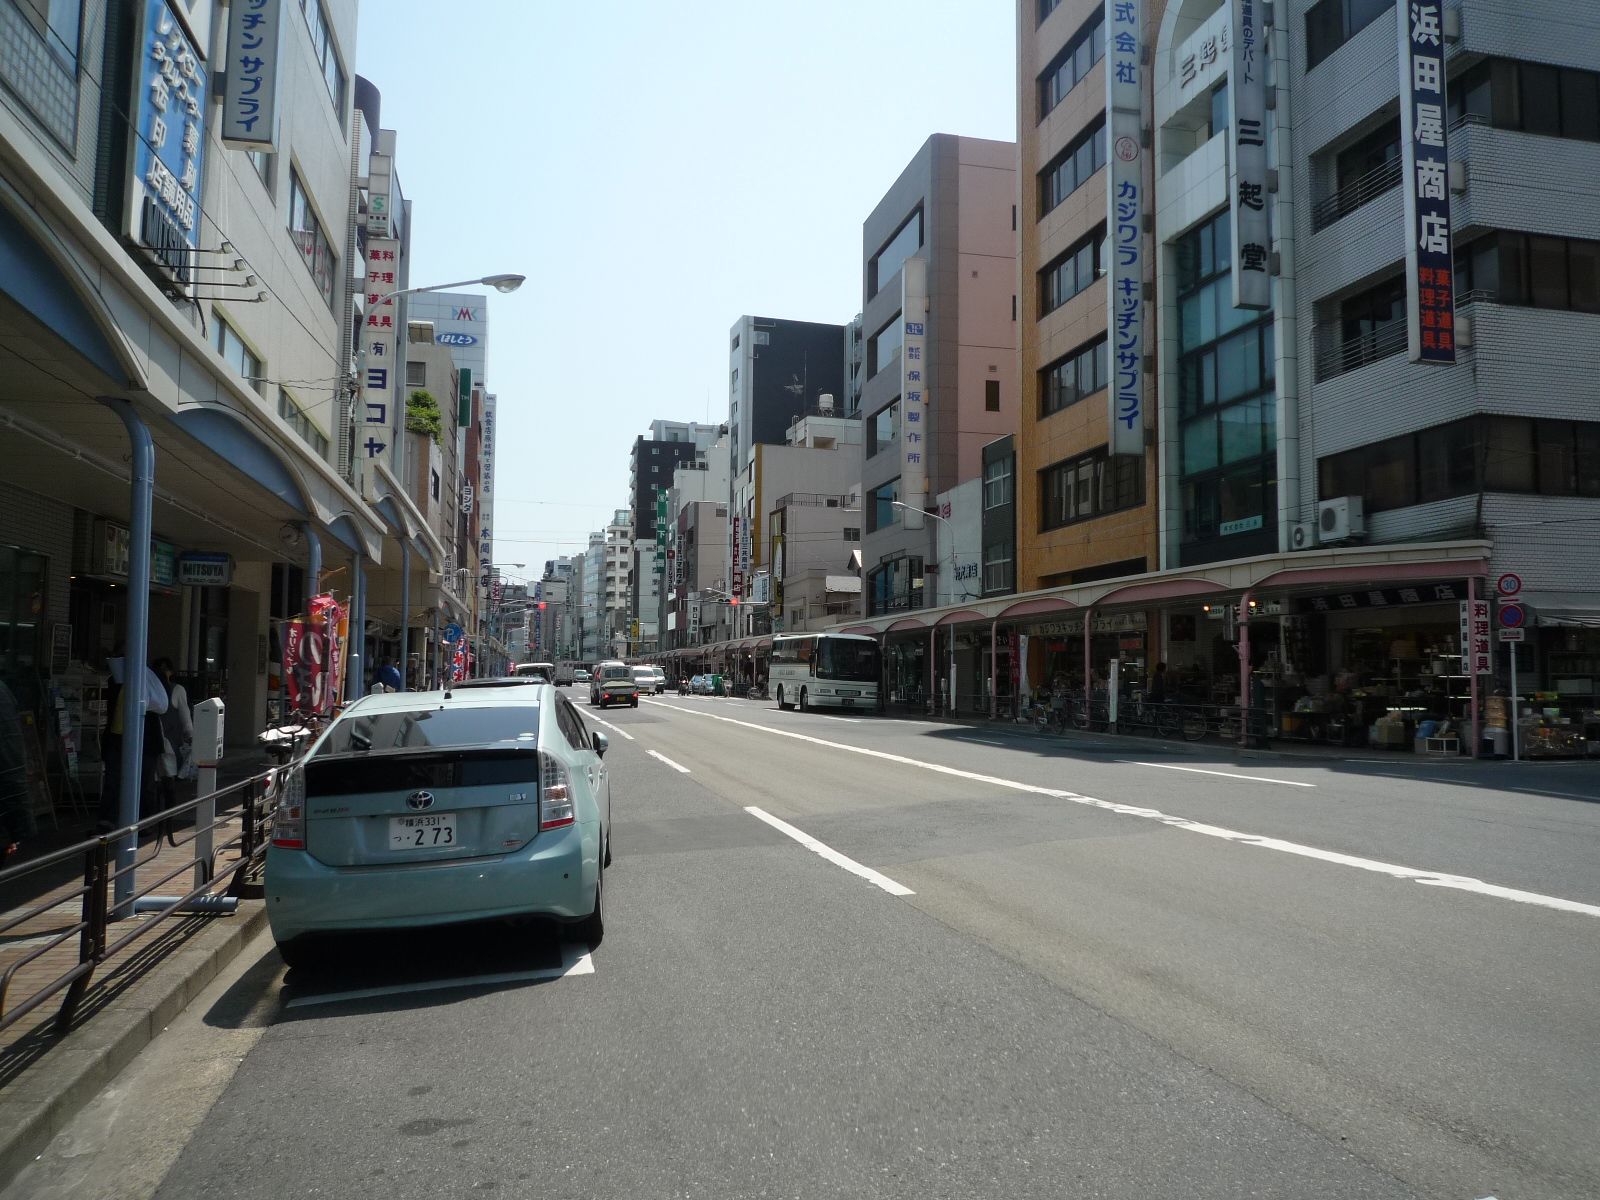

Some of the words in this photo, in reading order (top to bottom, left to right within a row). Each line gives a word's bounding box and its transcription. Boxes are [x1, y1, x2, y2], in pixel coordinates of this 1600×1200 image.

[1114, 2, 1136, 84] 式会社
[1410, 2, 1449, 255] 浜田屋商店
[1117, 180, 1138, 266] カジワラ
[1237, 117, 1267, 273] 三起堂
[440, 334, 473, 345] はしとう
[1116, 277, 1140, 430] キッチンサプライ
[364, 368, 388, 458] ヨコヤ
[907, 370, 921, 463] 保坂製作所
[1503, 579, 1517, 591] 30
[1474, 603, 1490, 671] 料理道具
[405, 816, 440, 828] 横浜331
[414, 827, 453, 846] 273
